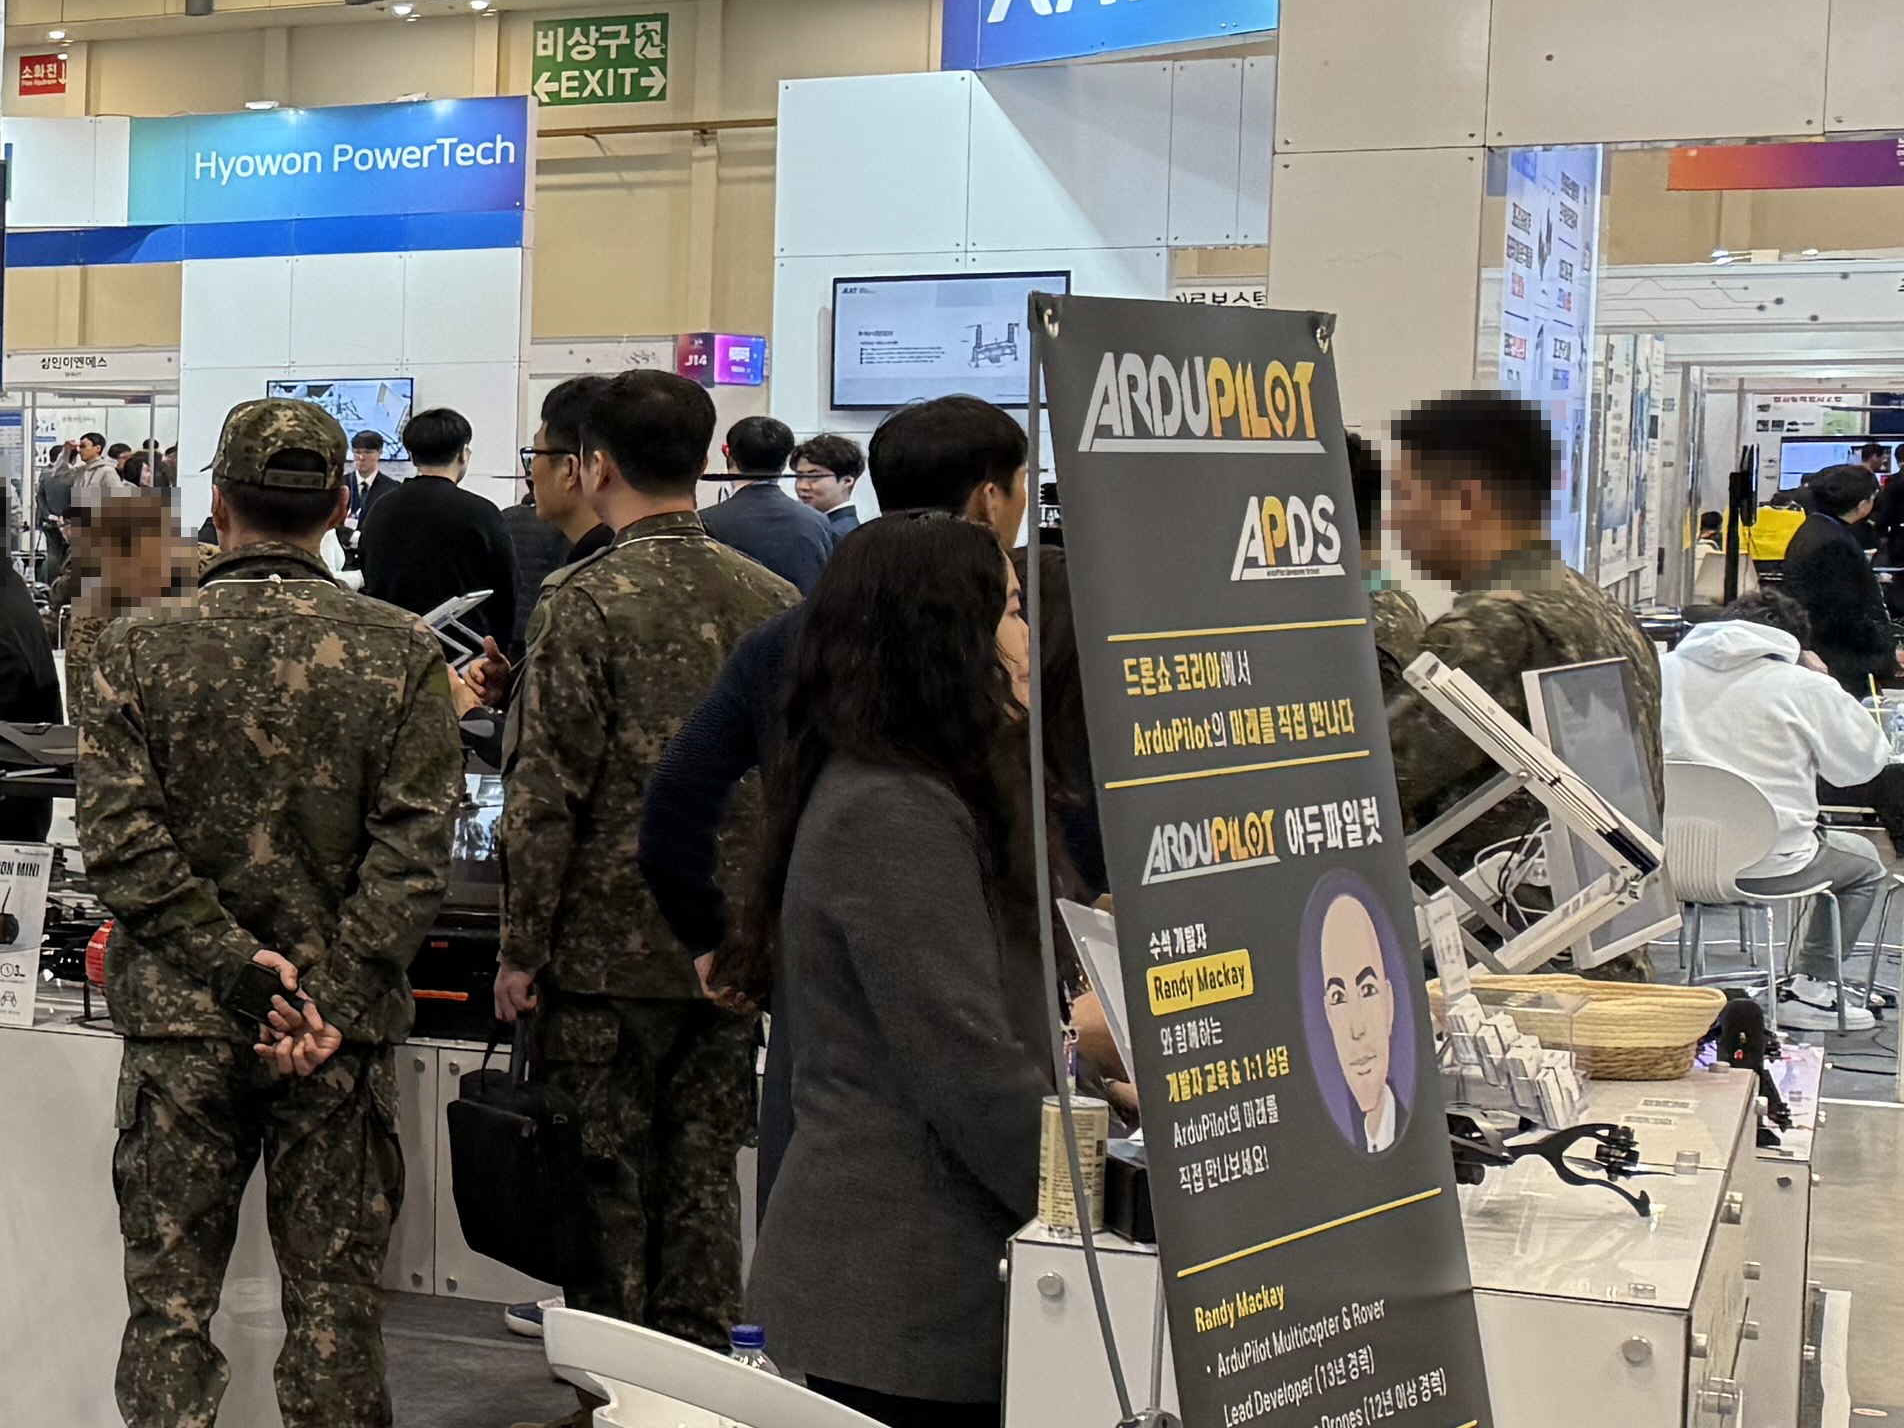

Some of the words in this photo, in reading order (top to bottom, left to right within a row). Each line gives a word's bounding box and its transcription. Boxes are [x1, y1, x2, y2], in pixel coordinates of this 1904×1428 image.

[536, 25, 630, 60] 비상구
[560, 66, 639, 99] EXIT
[194, 148, 322, 186] Hyowon
[332, 133, 517, 172] PowerTech
[1078, 352, 1327, 454] ARDUPILOT
[1231, 494, 1346, 581] APDS
[1123, 656, 1172, 695] 드론쇼
[1174, 650, 1251, 690] 코리아에서
[1133, 712, 1226, 755] ArduPilot의
[1228, 706, 1275, 745] 미래를
[1276, 702, 1307, 740] 직접
[1308, 698, 1354, 737] 만나다
[1141, 808, 1280, 886] ARDUPILOT
[1284, 797, 1381, 854] 아두파일럿
[16, 862, 41, 878] MINI
[1153, 971, 1193, 1003] Randy
[1196, 962, 1245, 992] Mackay
[1165, 1066, 1203, 1102] 개발자
[1242, 1053, 1263, 1081] 1:1
[1265, 1045, 1289, 1077] 상담
[1173, 1104, 1241, 1147] ArduPilot의
[1194, 1298, 1234, 1332] Randy
[1235, 1284, 1284, 1317] Mackay
[1217, 1337, 1272, 1377] ArduPilot
[1271, 1315, 1339, 1355] Multicopter
[1341, 1305, 1352, 1331] &
[1351, 1298, 1384, 1326] Rover
[1223, 1393, 1254, 1428] Lead
[1253, 1376, 1312, 1415] Developer
[1314, 1356, 1346, 1394] (13년
[1346, 1344, 1374, 1380] 경력)
[1362, 1388, 1394, 1425] (12년
[1394, 1378, 1418, 1409] 이상
[1418, 1367, 1447, 1402] 경력)
